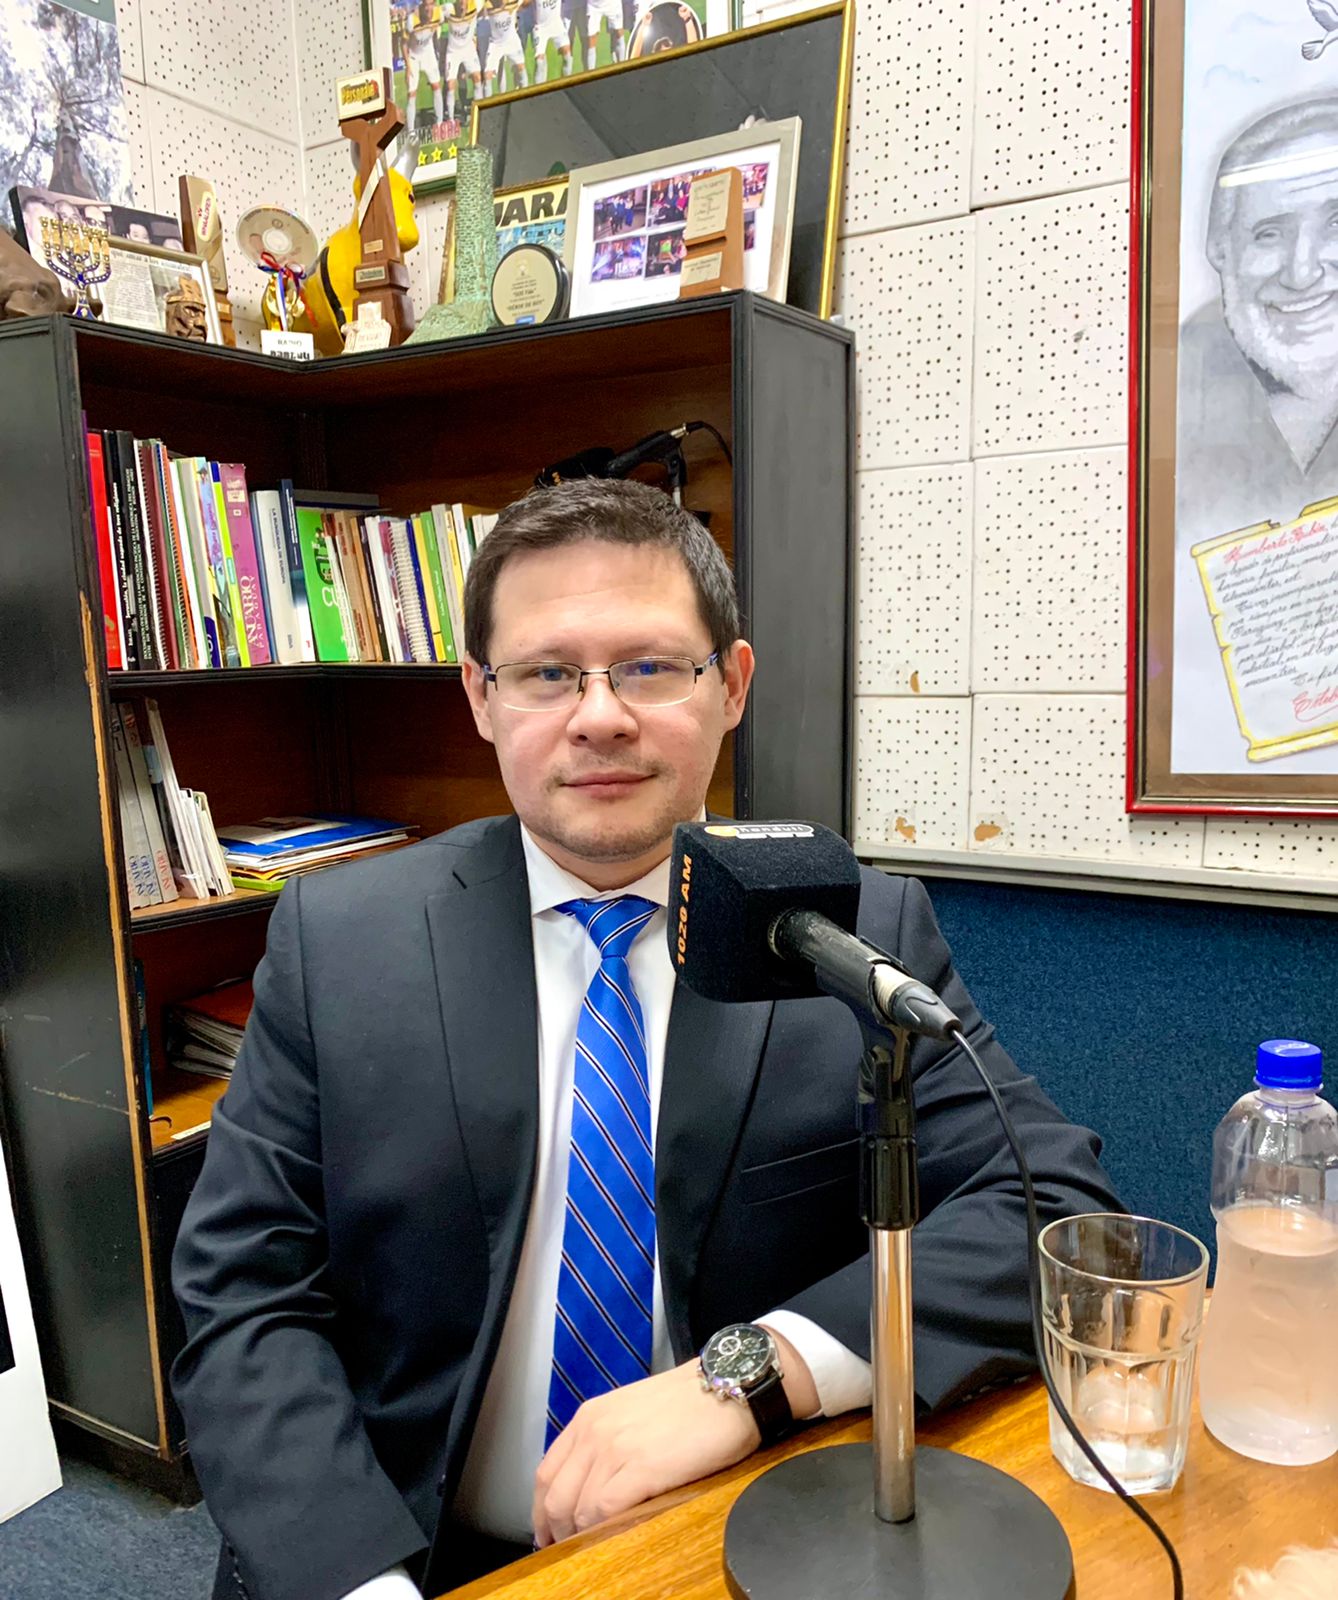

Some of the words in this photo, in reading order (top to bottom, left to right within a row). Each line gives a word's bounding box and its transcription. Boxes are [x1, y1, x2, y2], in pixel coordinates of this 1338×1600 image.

[239, 575, 259, 646] ANUARIO
[250, 575, 265, 648] PARAGUAY
[681, 853, 692, 903] AM
[677, 905, 688, 966] 1020
